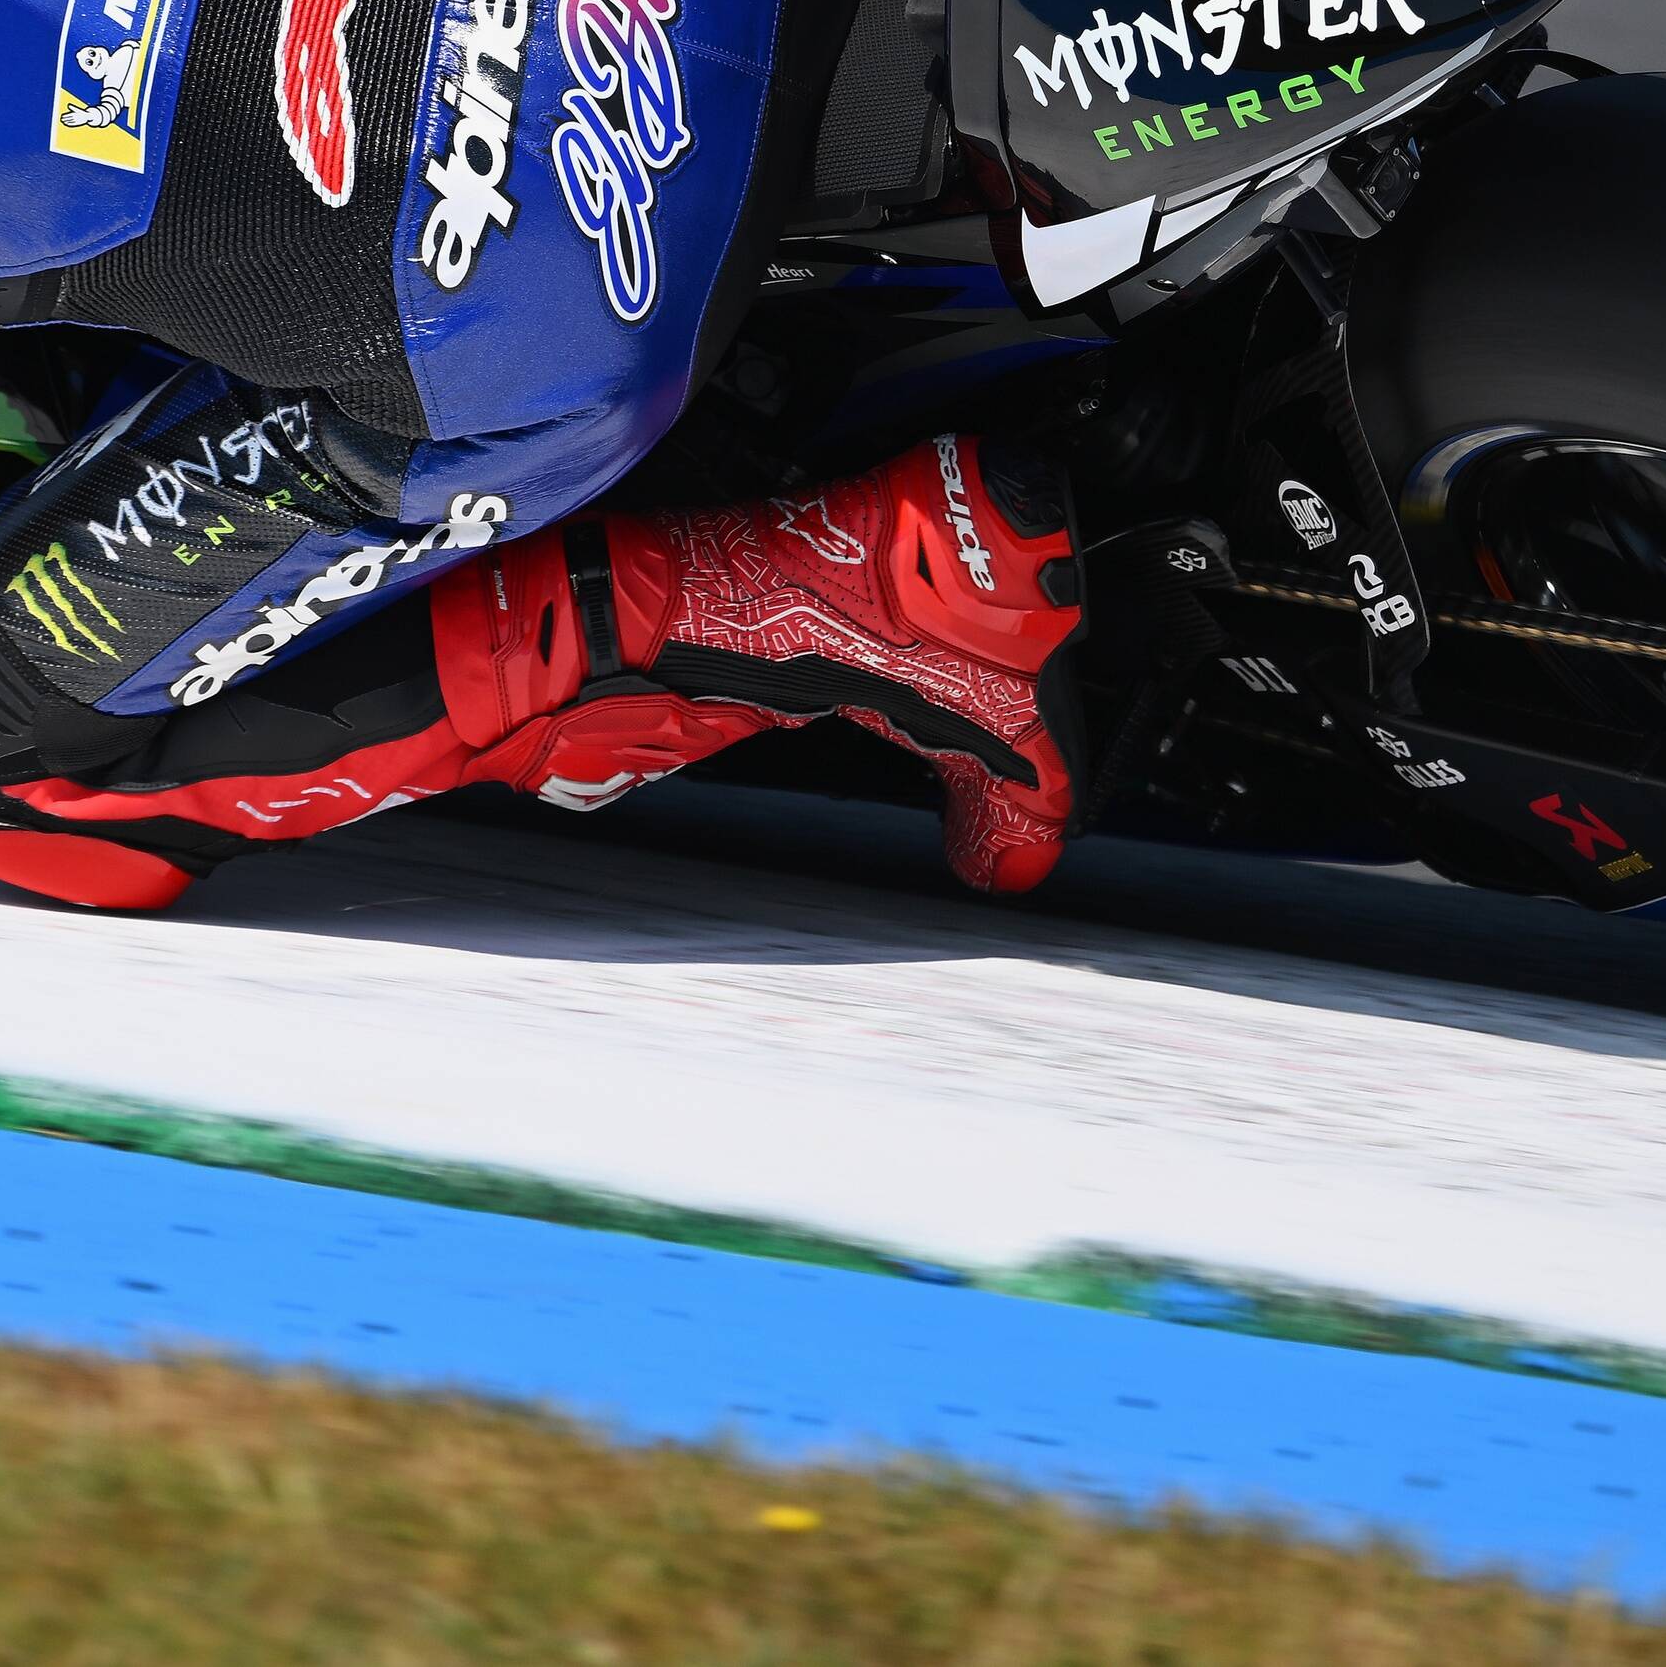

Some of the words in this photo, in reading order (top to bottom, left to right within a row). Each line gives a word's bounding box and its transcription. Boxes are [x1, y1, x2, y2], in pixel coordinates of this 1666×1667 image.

[1094, 57, 1366, 161] ENERGY
[1289, 495, 1330, 534] BMC
[1361, 595, 1415, 637] RCB
[1393, 758, 1466, 789] GILLES
